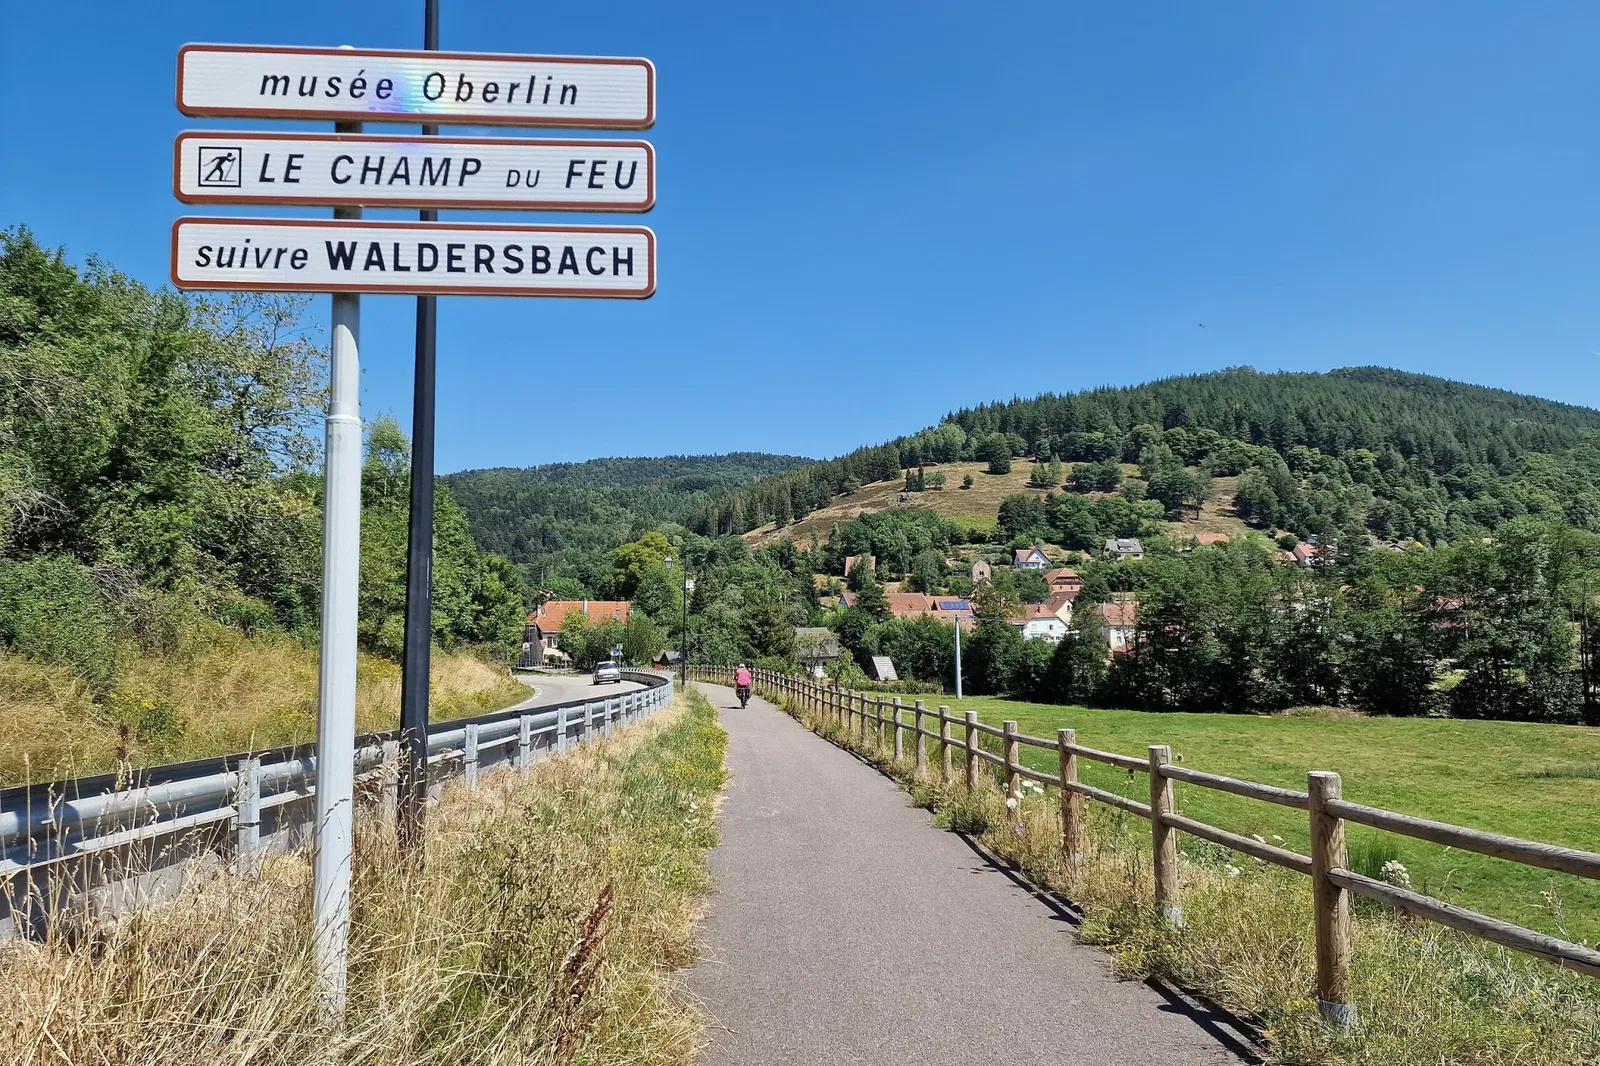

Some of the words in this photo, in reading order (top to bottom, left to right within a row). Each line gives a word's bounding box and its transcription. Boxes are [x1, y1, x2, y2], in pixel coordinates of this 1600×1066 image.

[260, 70, 394, 99] musée
[423, 72, 578, 105] Oberlin
[259, 153, 304, 183] LE
[331, 155, 482, 187] CHAMP
[506, 169, 540, 188] DU
[566, 160, 638, 190] FEU
[195, 239, 308, 270] suivre
[325, 241, 634, 276] WALDERSBACH
